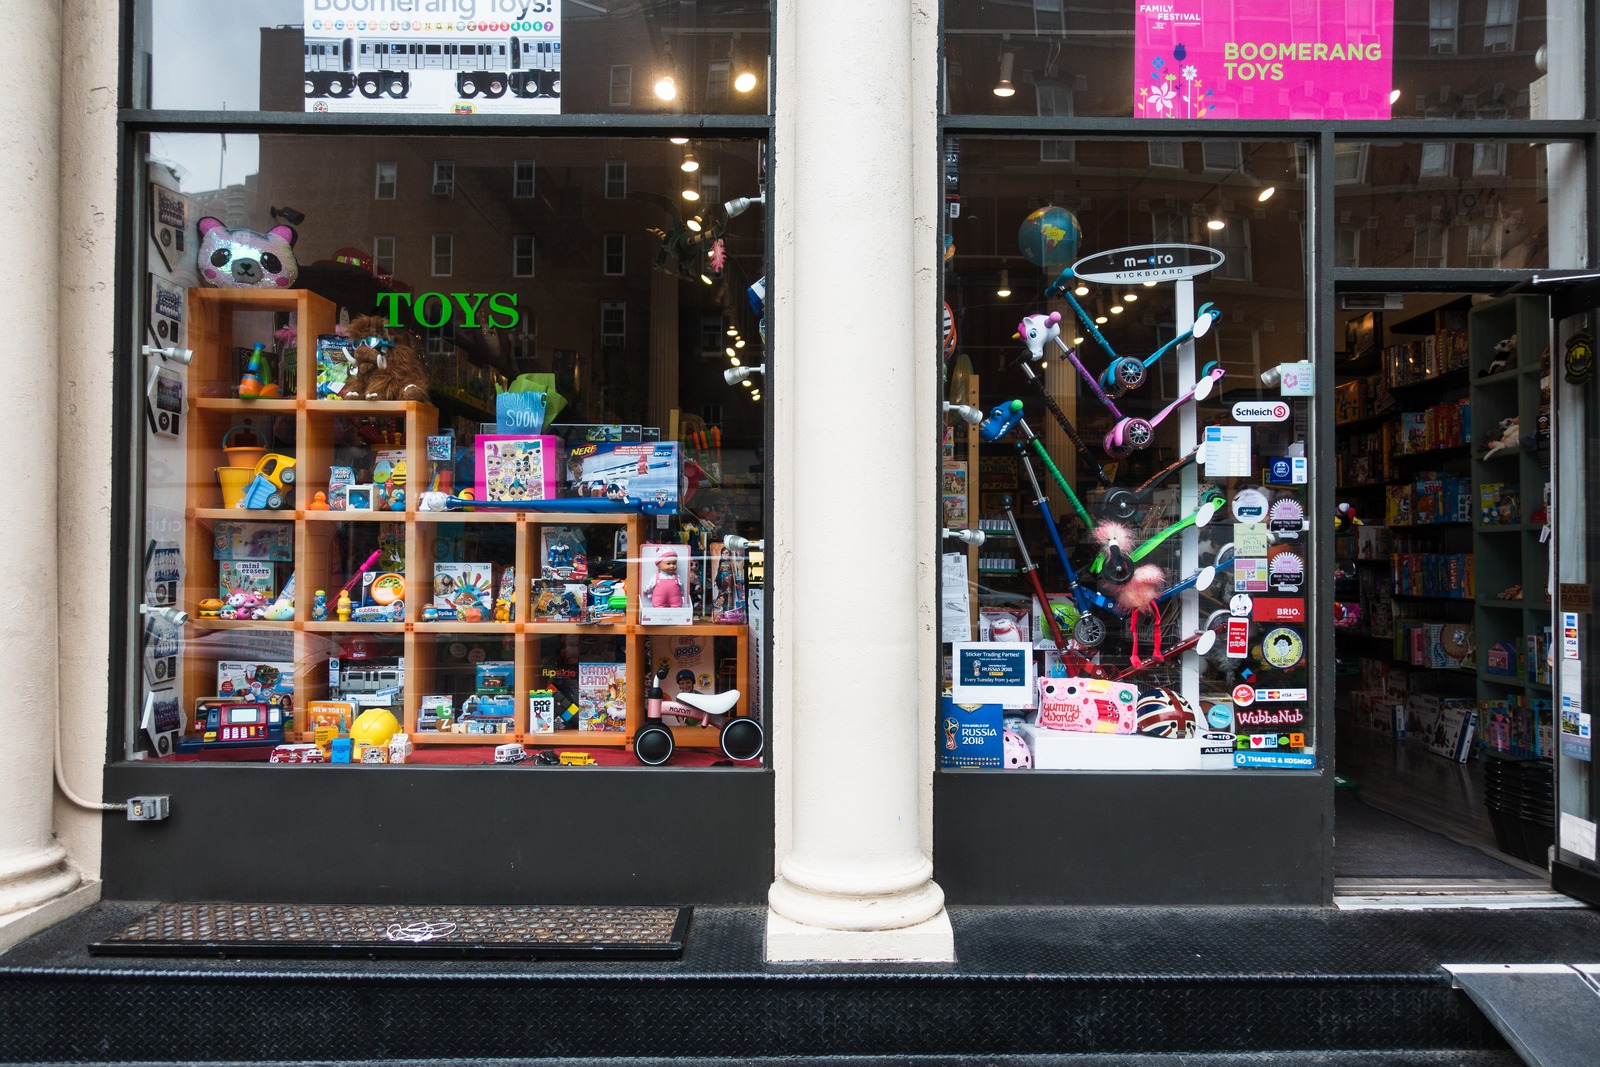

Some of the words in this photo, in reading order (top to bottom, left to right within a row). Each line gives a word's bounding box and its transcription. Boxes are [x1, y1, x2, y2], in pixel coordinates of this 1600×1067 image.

[1224, 42, 1382, 60] BOOMERANG
[1224, 63, 1284, 80] TOYS
[1116, 268, 1184, 279] KICKBOARD
[376, 292, 520, 329] TOYS
[502, 392, 548, 409] COMING
[1236, 408, 1272, 416] Schleich
[505, 410, 540, 428] SOON
[570, 444, 598, 456] NERF
[1561, 586, 1590, 594] ZAGAT
[1561, 594, 1590, 603] RATED
[676, 646, 700, 657] pogo
[581, 666, 617, 675] CANDY
[581, 676, 608, 685] LAND
[443, 705, 451, 716] 5
[1044, 703, 1081, 719] yummy
[1237, 709, 1303, 724] WubbaNub
[441, 719, 450, 729] Z
